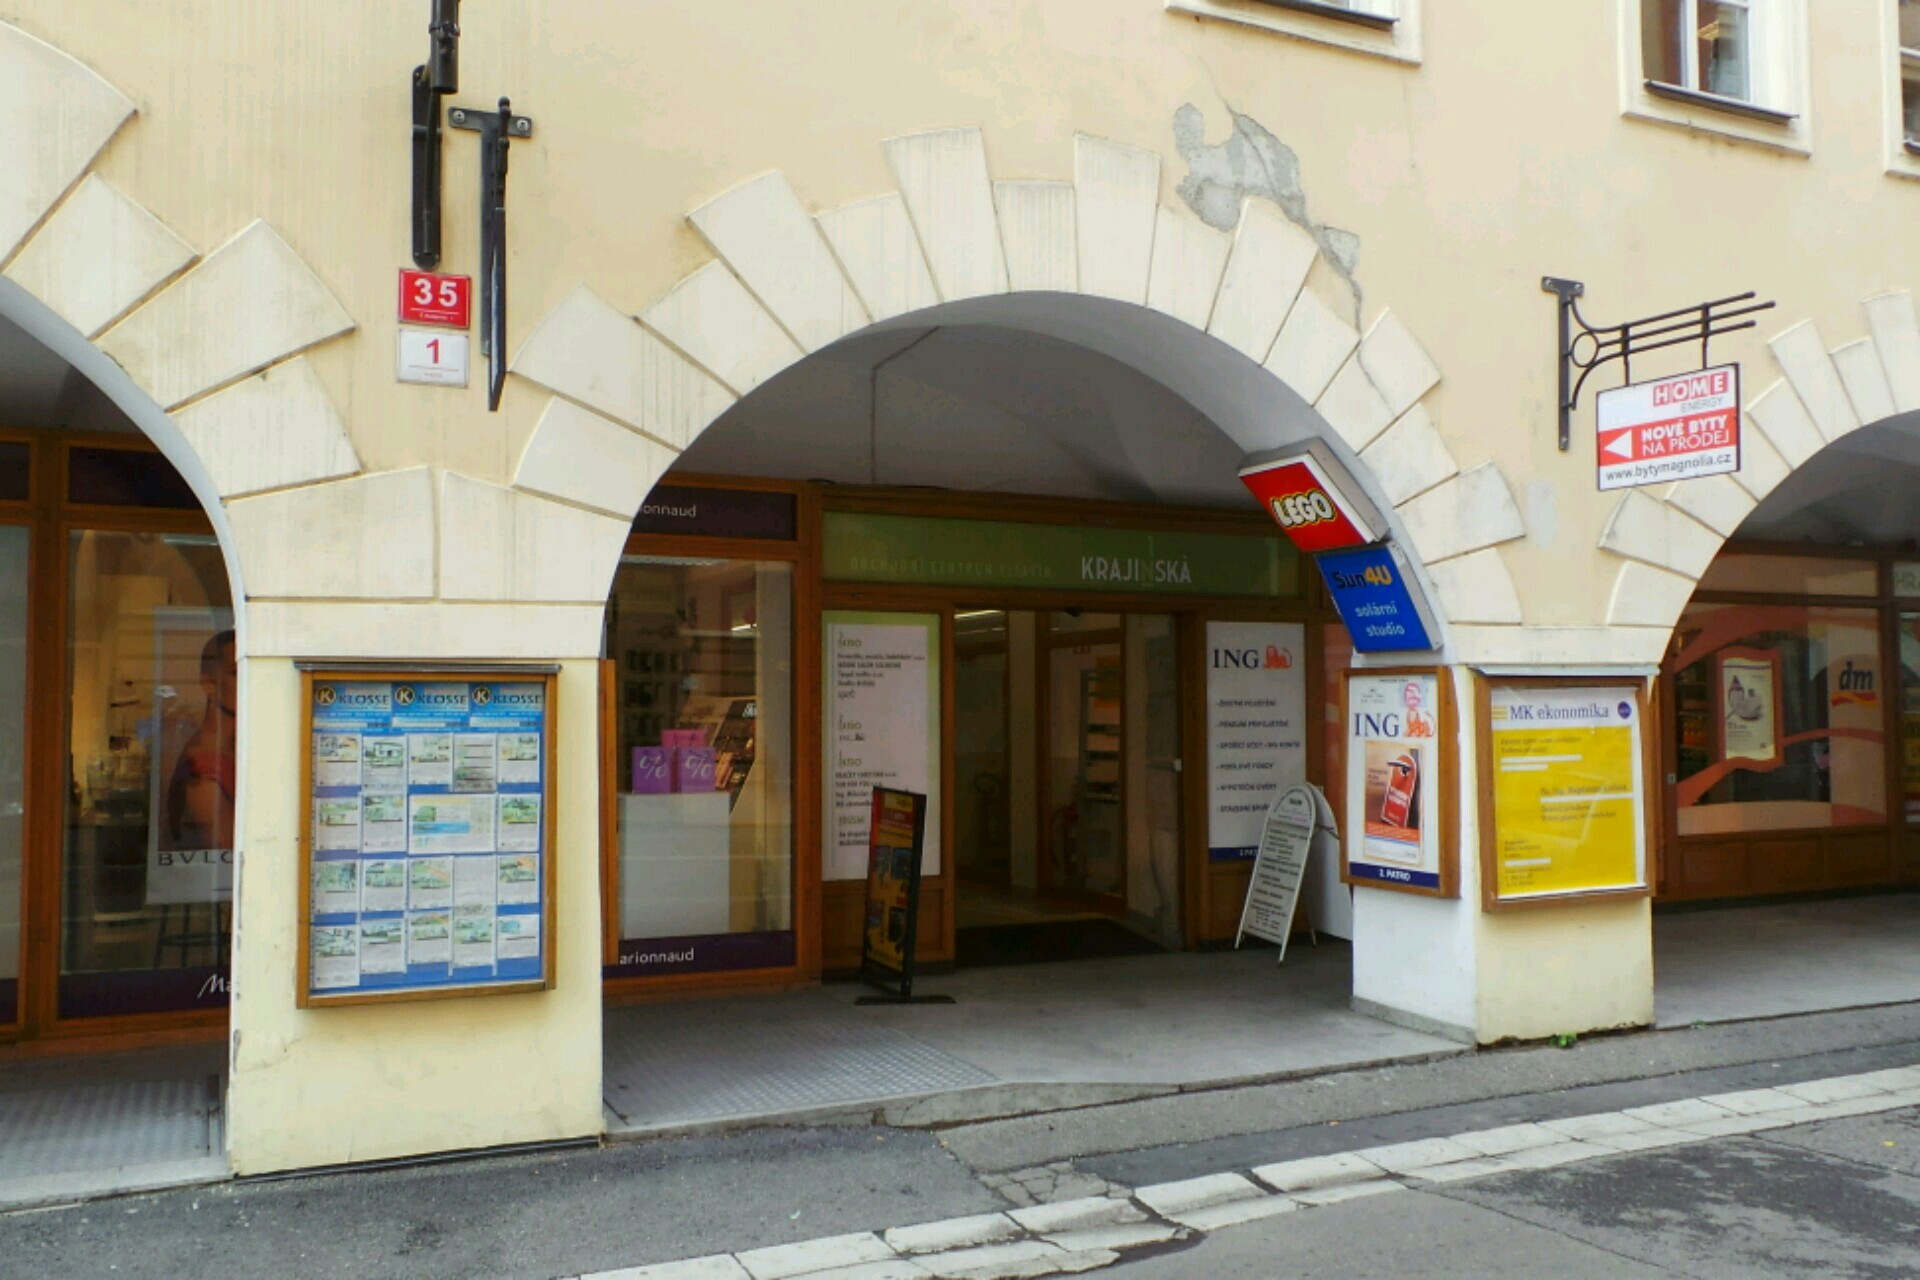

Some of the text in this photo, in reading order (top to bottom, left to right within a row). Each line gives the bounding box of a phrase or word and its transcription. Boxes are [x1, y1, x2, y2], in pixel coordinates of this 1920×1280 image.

[414, 278, 458, 307] 35
[426, 339, 439, 364] 1
[1654, 372, 1728, 406] HOME
[1681, 397, 1724, 413] ENERGY
[1641, 415, 1728, 441] NOVÉ BYTY
[1642, 430, 1729, 456] NA PRODEJ
[1605, 453, 1732, 481] www.bytymagnolia.cz
[1272, 490, 1335, 527] LEGO
[1332, 565, 1392, 589] Sun4U
[1355, 600, 1397, 617] solární
[1365, 621, 1405, 637] studio
[1213, 648, 1260, 670] ING
[1839, 661, 1874, 691] dm
[1354, 712, 1399, 737] ING
[1510, 703, 1609, 721] MK ekonomika
